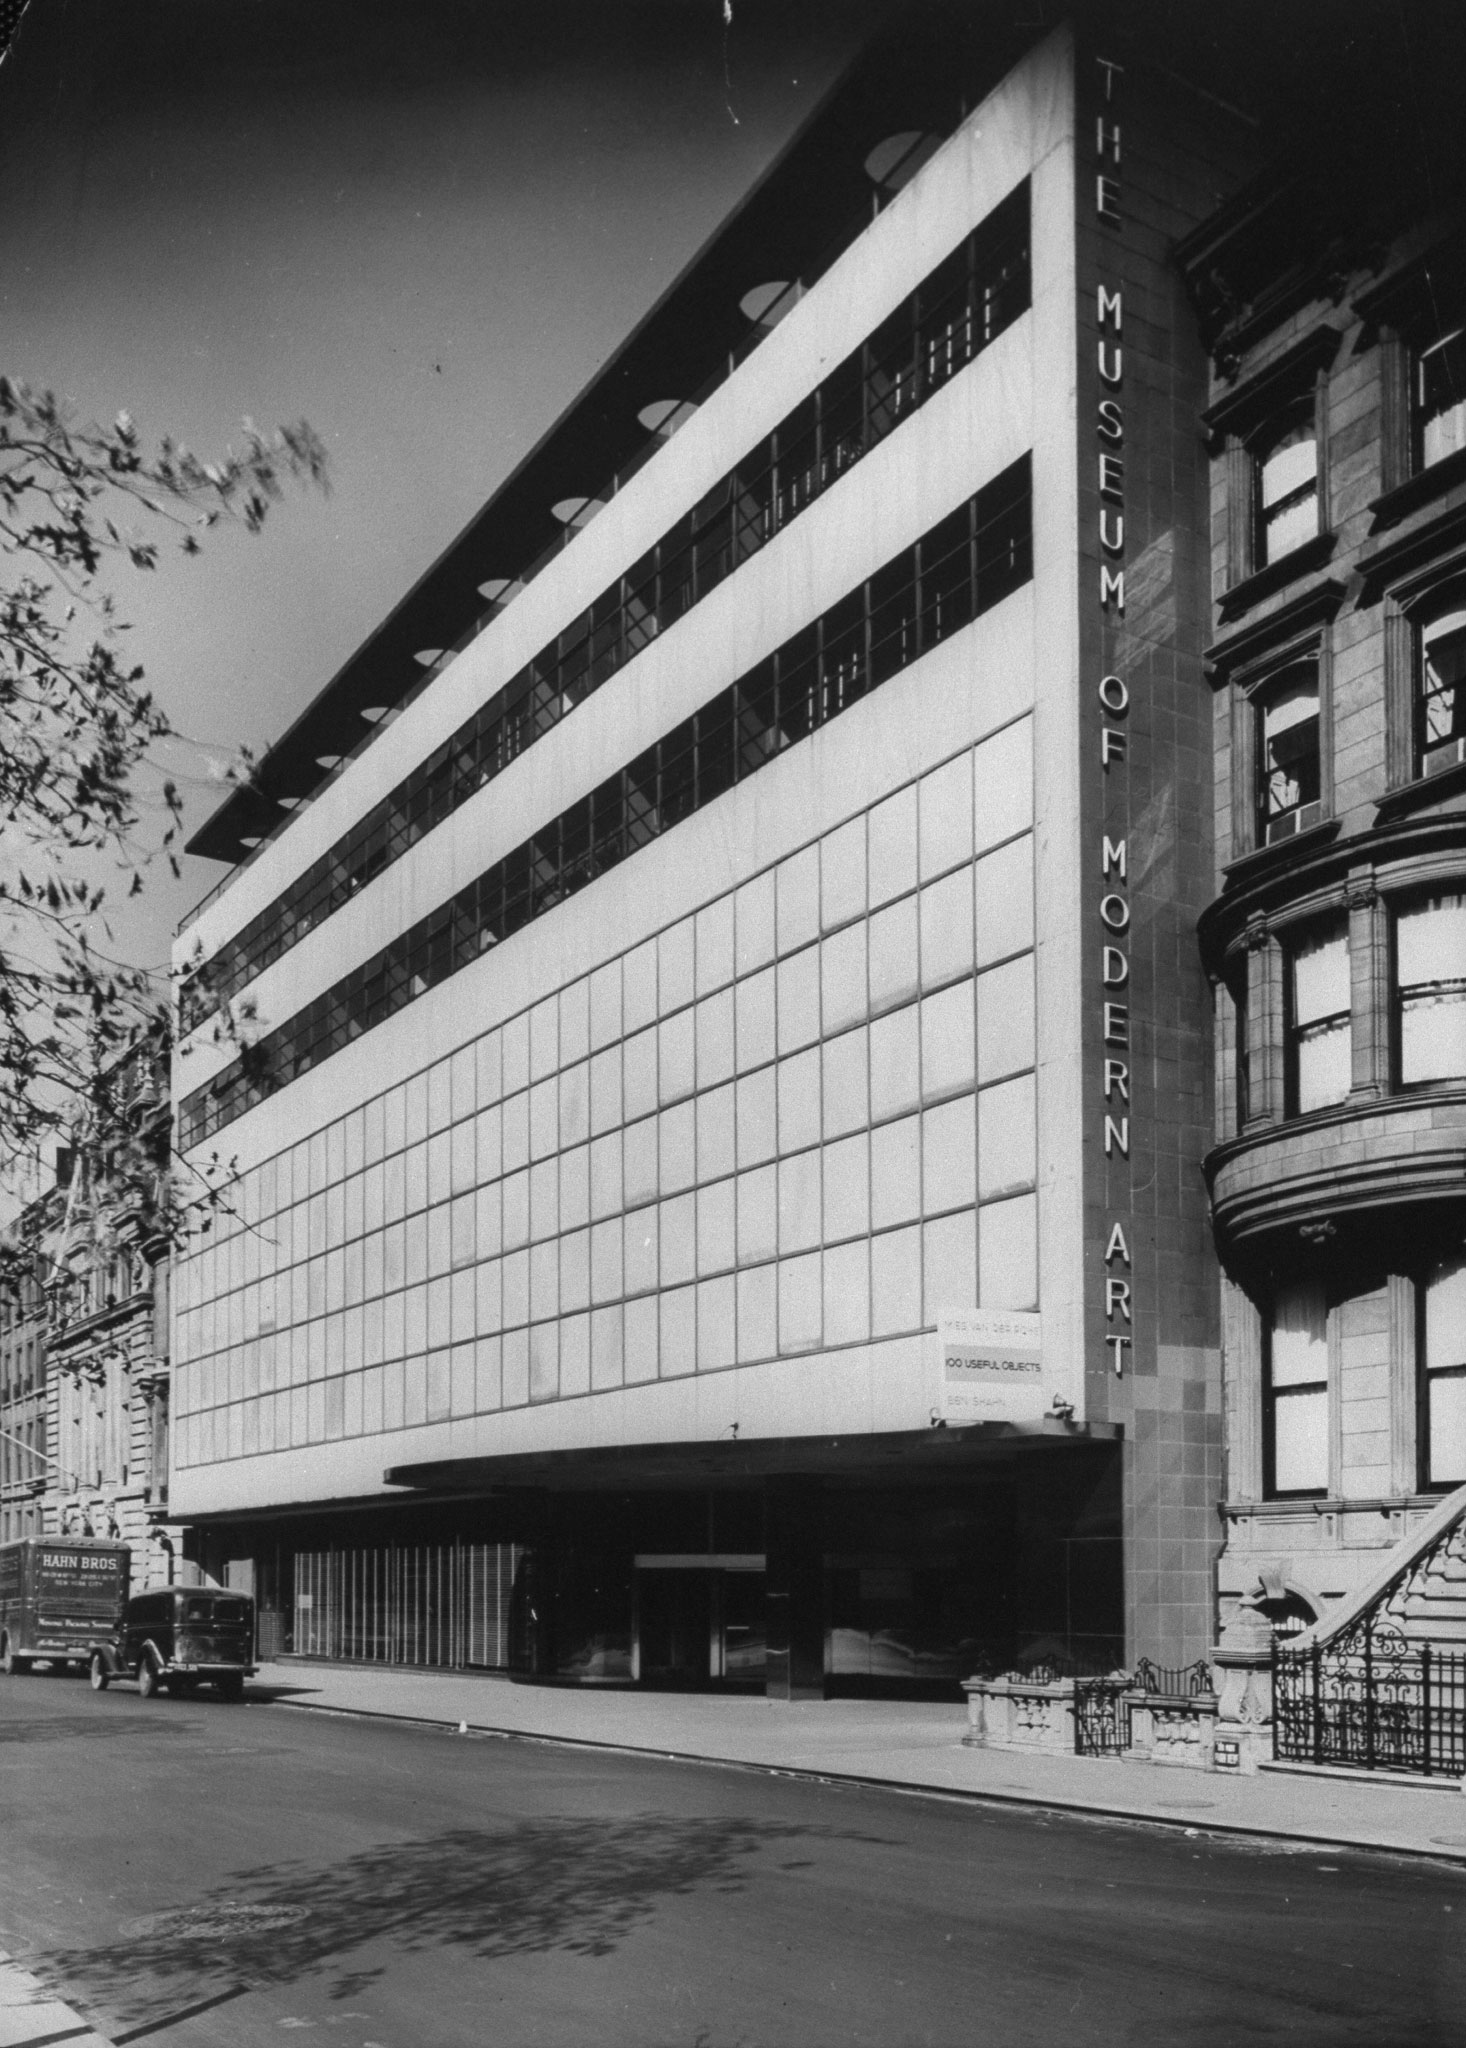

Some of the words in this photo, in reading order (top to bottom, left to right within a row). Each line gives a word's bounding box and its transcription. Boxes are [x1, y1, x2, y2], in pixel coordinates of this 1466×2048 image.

[1096, 58, 1124, 220] THE
[1098, 284, 1124, 608] MUSEUM
[1100, 676, 1128, 764] OF
[1100, 836, 1130, 1153] MODERN
[965, 1359, 1000, 1370] USEFUL
[1002, 1360, 1042, 1372] OBJECTS
[1105, 1222, 1131, 1373] ART
[43, 1554, 78, 1568] HAHN
